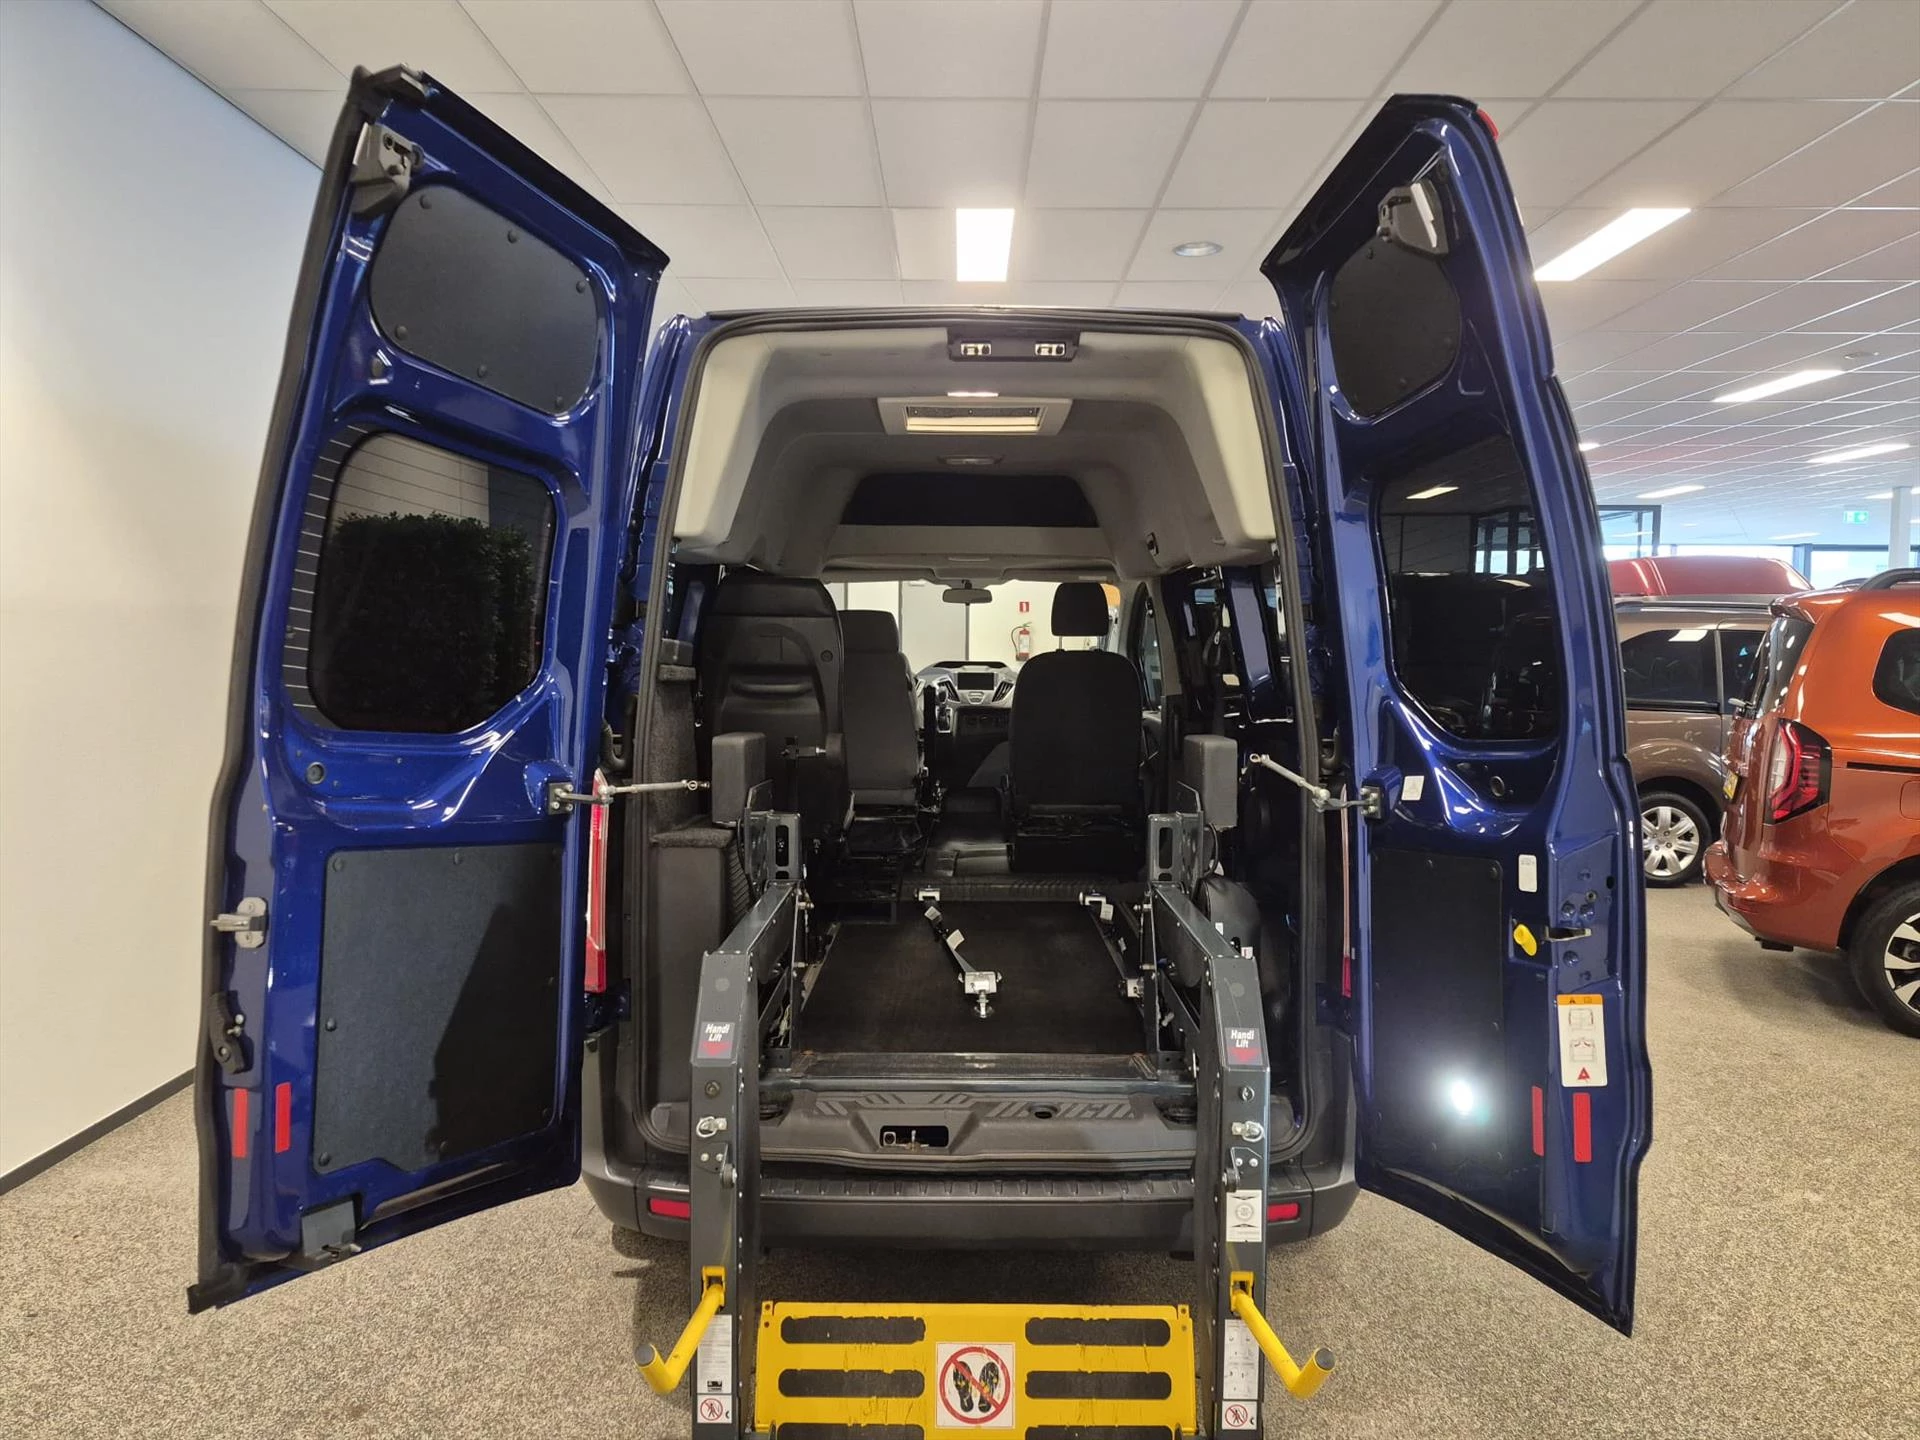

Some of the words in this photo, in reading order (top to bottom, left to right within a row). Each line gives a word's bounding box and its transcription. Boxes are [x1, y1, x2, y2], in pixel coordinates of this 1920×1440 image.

[705, 1023, 730, 1034] Handi
[708, 1033, 722, 1042] Lift
[1231, 1029, 1255, 1040] Handi
[1235, 1039, 1249, 1048] Lift
